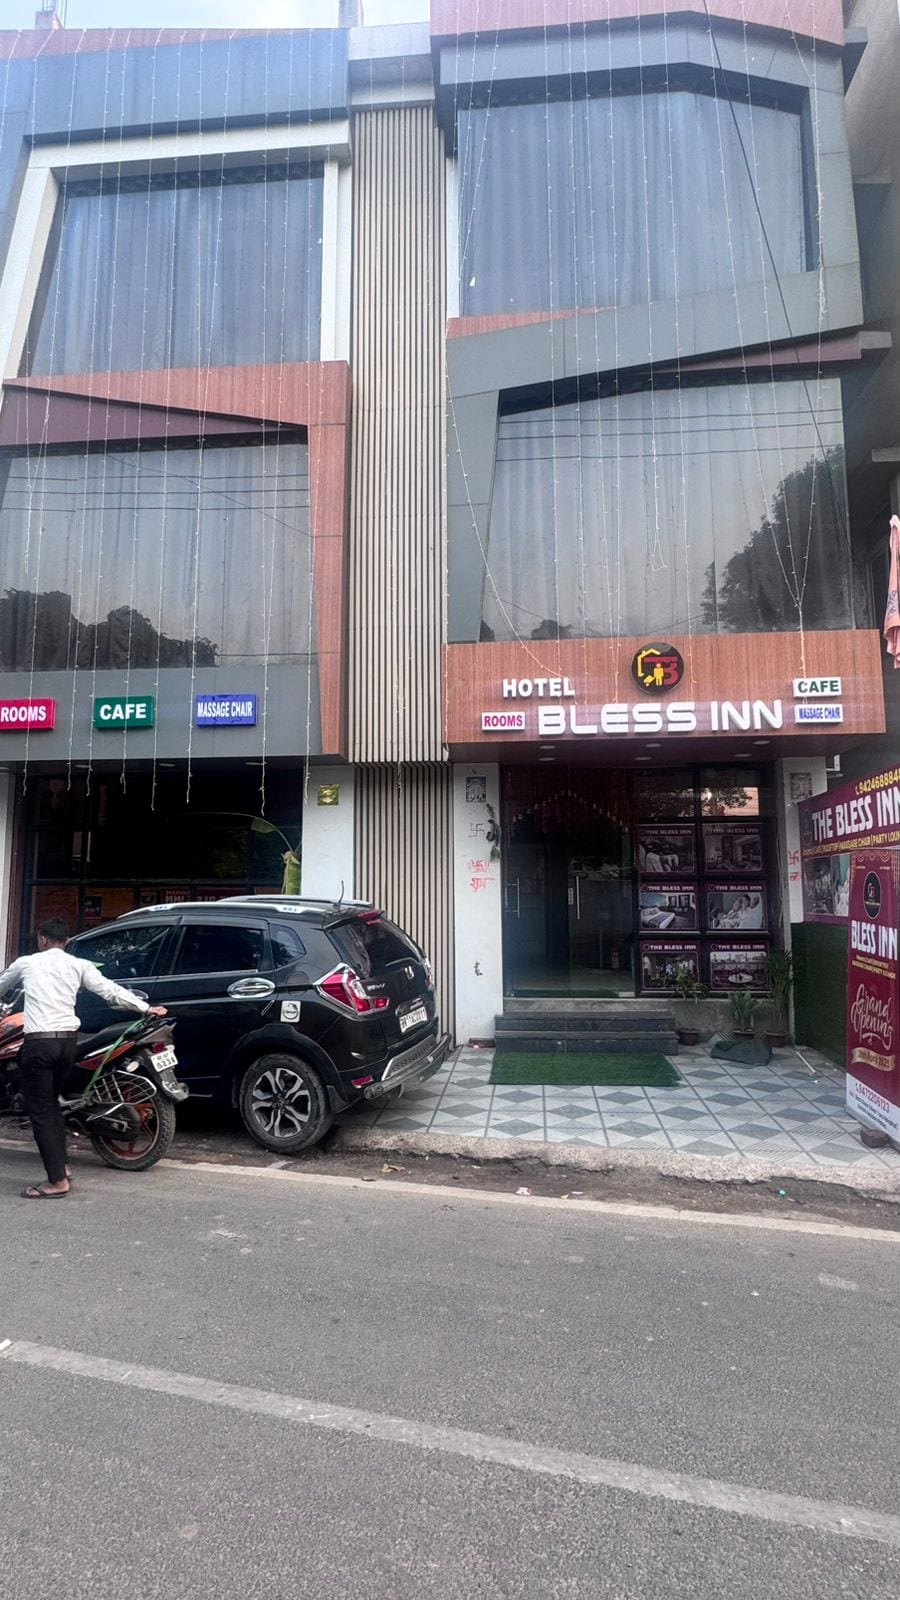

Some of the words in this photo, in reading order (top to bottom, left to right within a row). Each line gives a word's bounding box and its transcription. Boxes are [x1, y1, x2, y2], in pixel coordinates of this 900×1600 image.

[502, 677, 576, 698] HOTEL
[797, 679, 840, 694] CAFE
[0, 705, 47, 723] ROOMS
[99, 702, 147, 721] CAFE
[197, 701, 230, 718] MASSAGE
[231, 700, 254, 717] CHAIR
[538, 701, 697, 735] BLESS
[710, 699, 783, 732] INN
[799, 706, 823, 720] MASSAGE
[823, 706, 841, 719] CHAIR
[483, 714, 523, 727] ROOMS
[812, 807, 833, 842] THE
[835, 795, 874, 836] BLESS
[876, 785, 900, 828] INN
[873, 832, 887, 845] PARTY
[851, 920, 876, 954] BLESS
[878, 925, 898, 961] INN
[855, 983, 892, 1023] Grand
